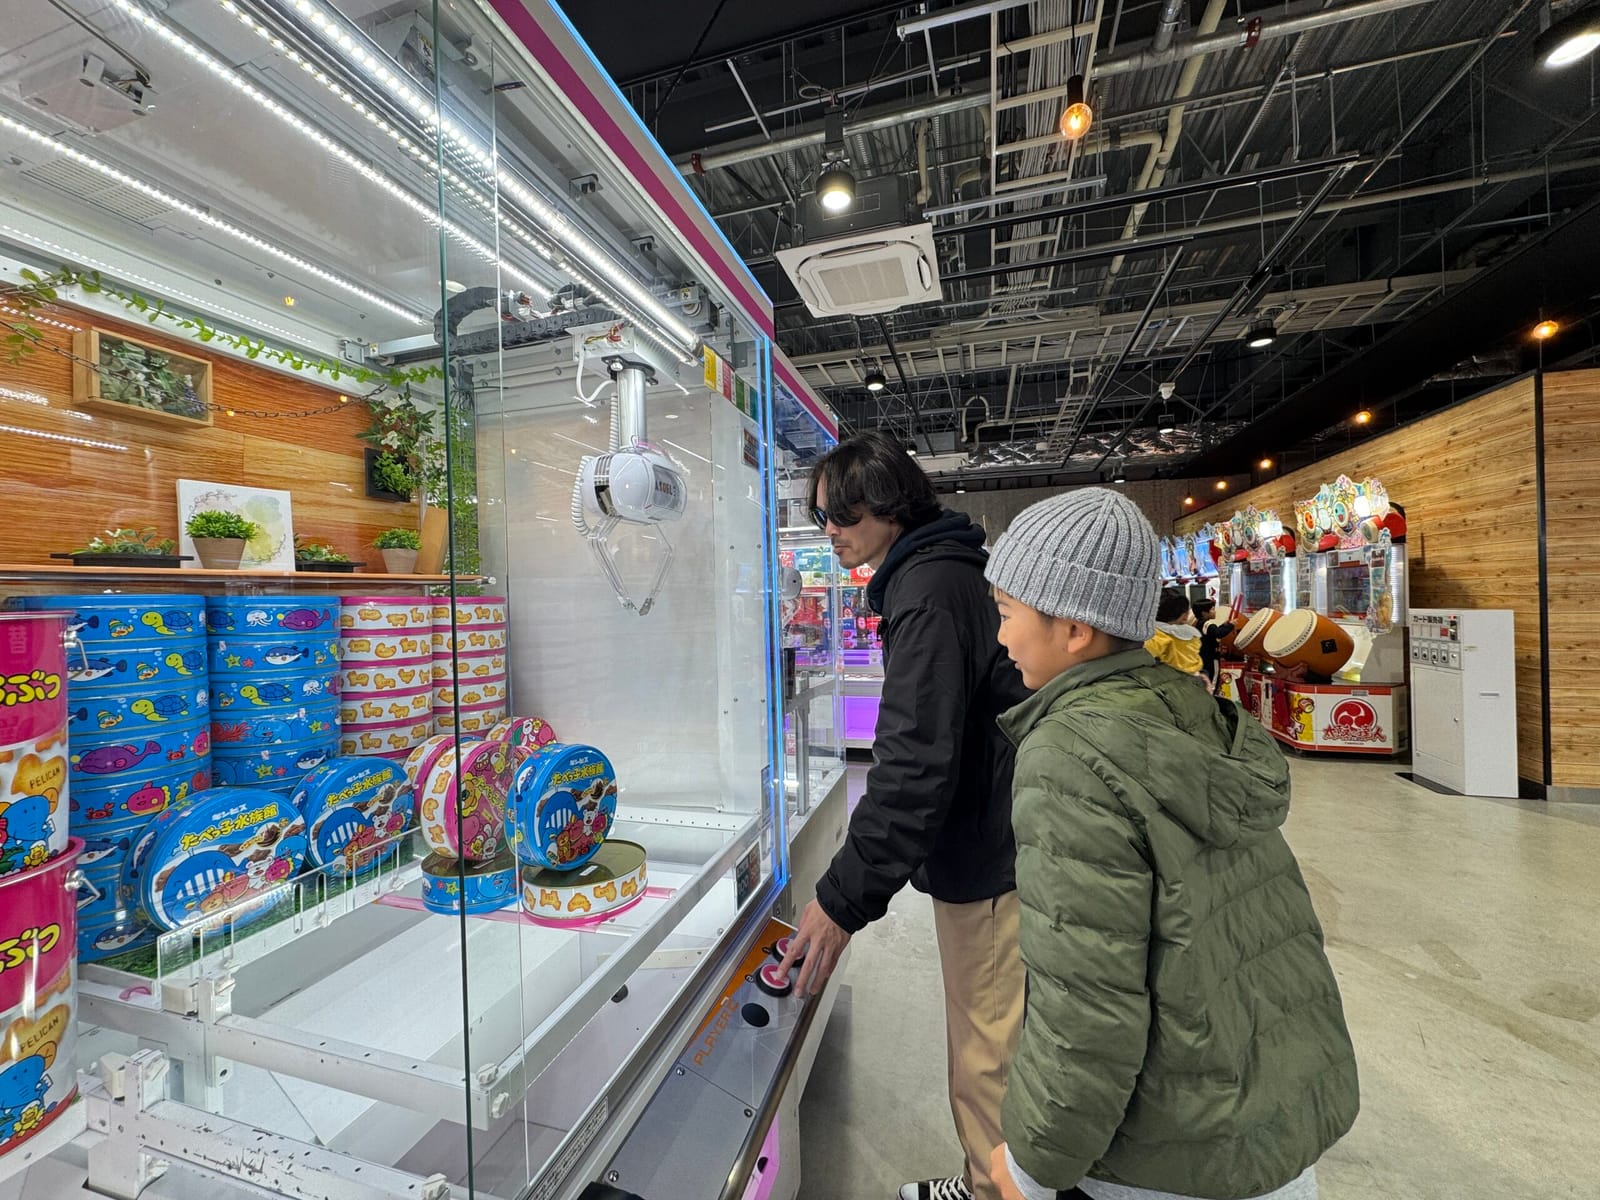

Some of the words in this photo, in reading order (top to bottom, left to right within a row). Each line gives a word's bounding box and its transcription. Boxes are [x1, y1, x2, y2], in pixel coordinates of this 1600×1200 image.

[30, 765, 60, 790] PELICAN
[327, 767, 393, 807] たべっ子水族館
[179, 802, 279, 852] たべっ子水族館
[693, 1010, 730, 1067] PLAYER
